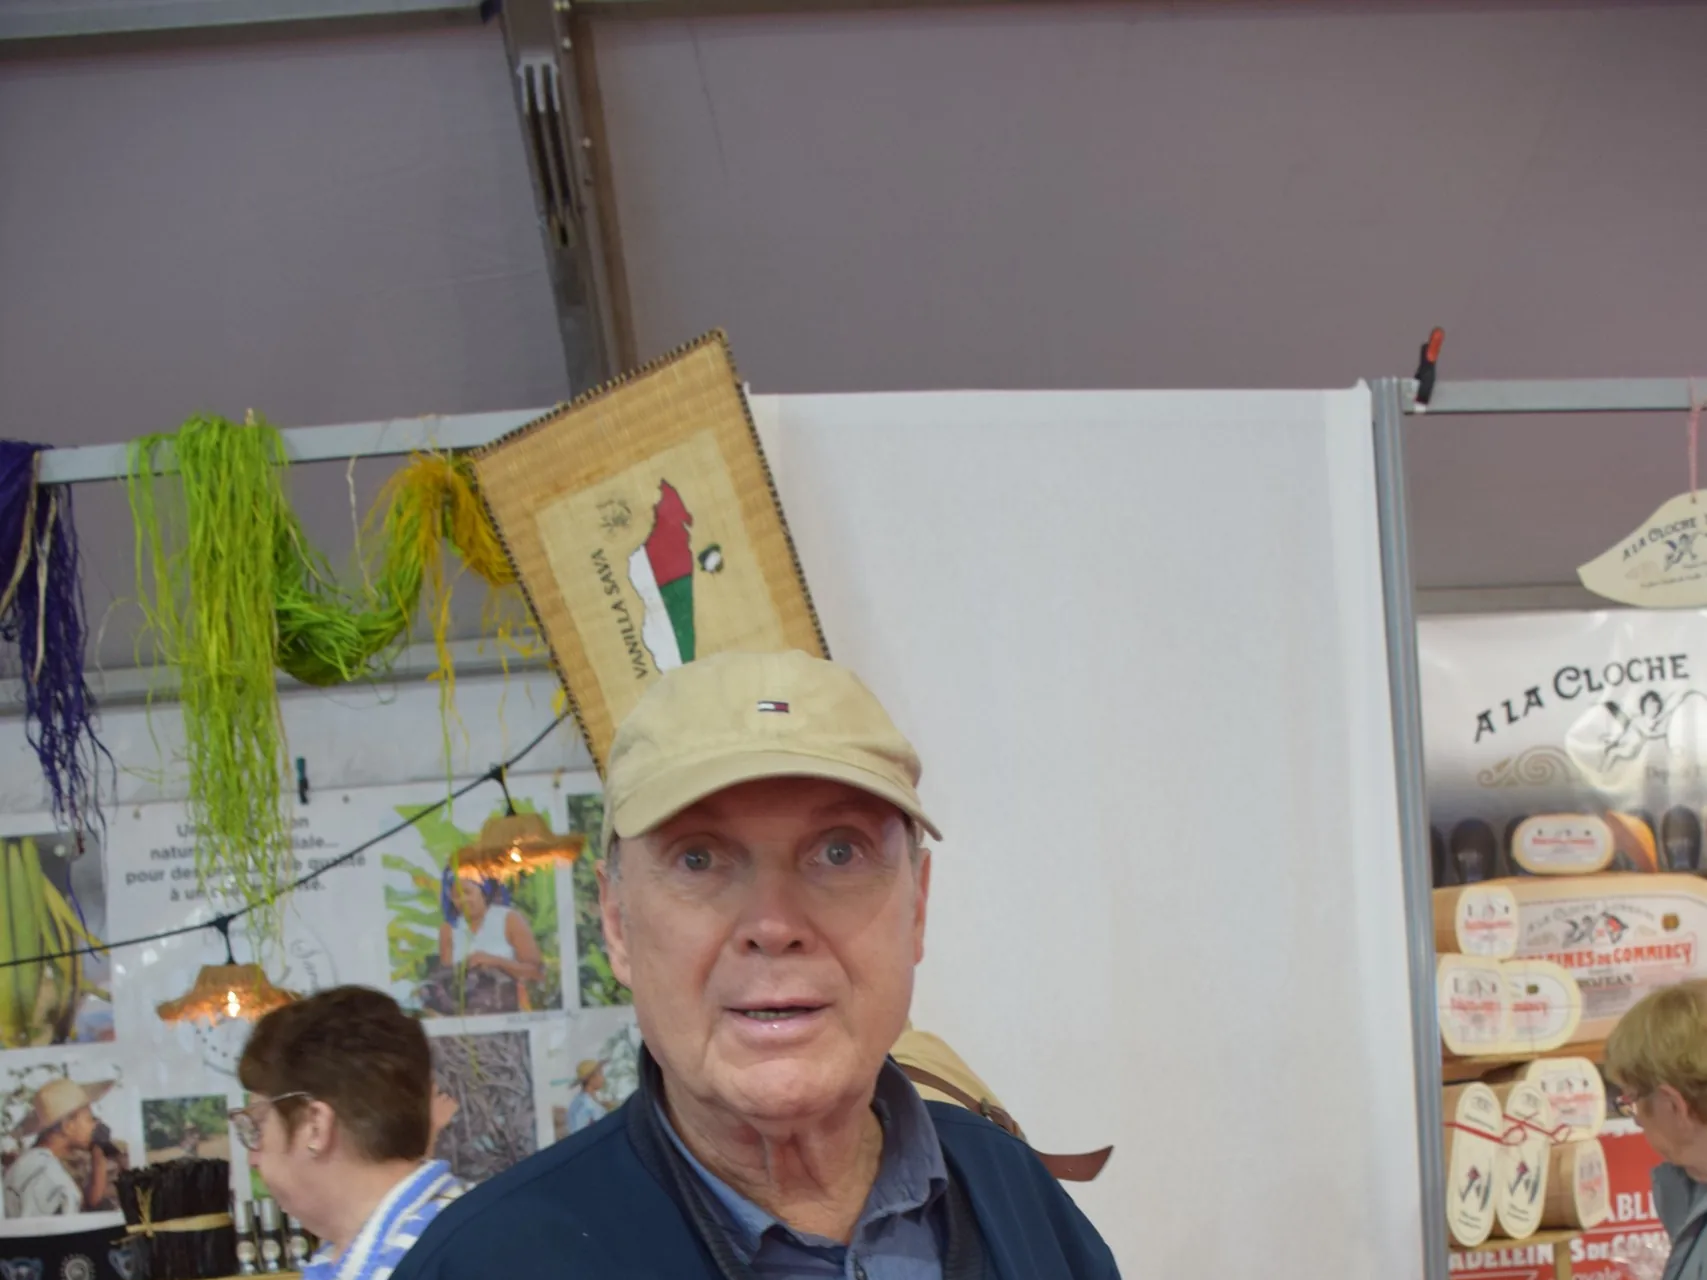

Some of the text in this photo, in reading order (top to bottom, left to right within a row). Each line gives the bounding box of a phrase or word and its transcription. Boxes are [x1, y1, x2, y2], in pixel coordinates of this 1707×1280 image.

[590, 548, 648, 680] VANILLA SAVA
[1474, 654, 1690, 743] A LA CLOCHE
[125, 869, 165, 885] pour
[1613, 942, 1692, 967] COMMERCY
